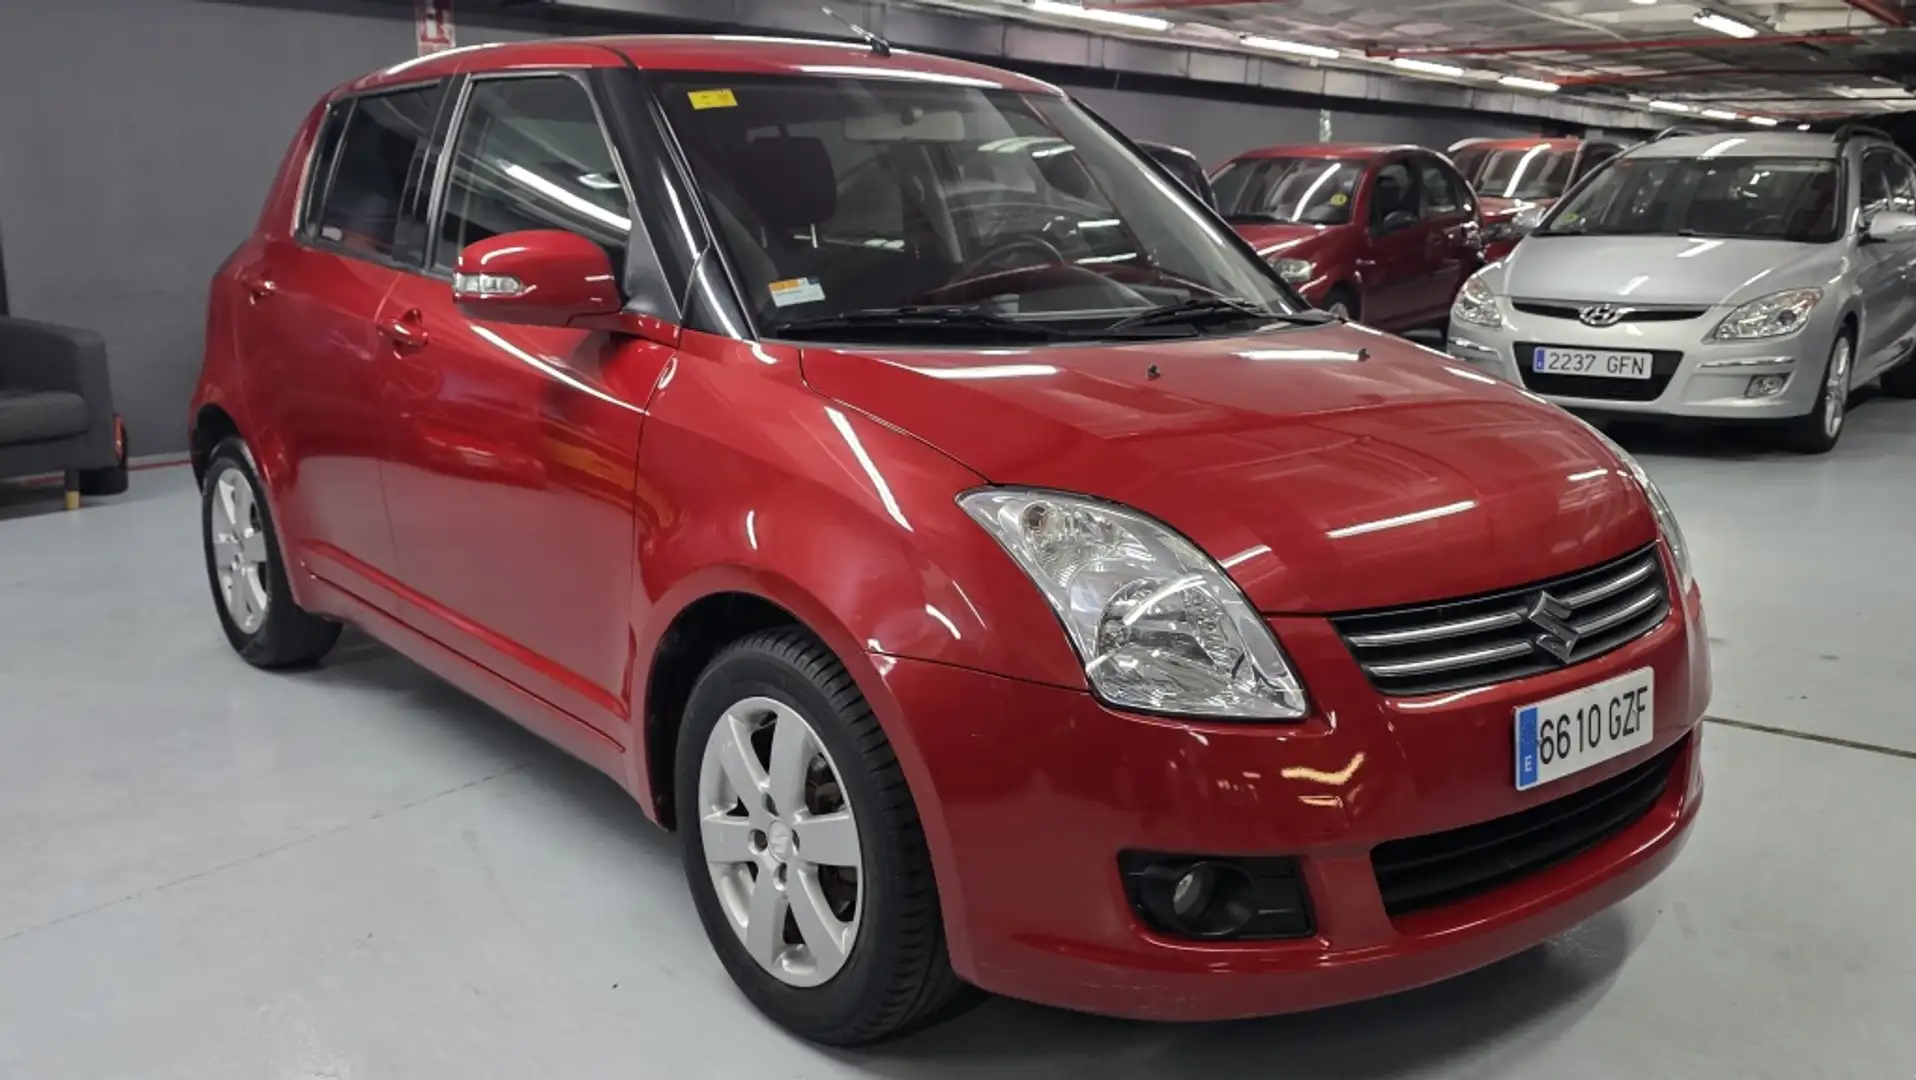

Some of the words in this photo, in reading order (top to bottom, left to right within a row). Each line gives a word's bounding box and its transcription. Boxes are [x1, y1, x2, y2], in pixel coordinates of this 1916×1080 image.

[1548, 352, 1597, 372] 2237
[1606, 355, 1645, 375] GFN
[1539, 704, 1602, 765] 6610
[1609, 685, 1648, 741] GZF
[1524, 754, 1533, 773] E
